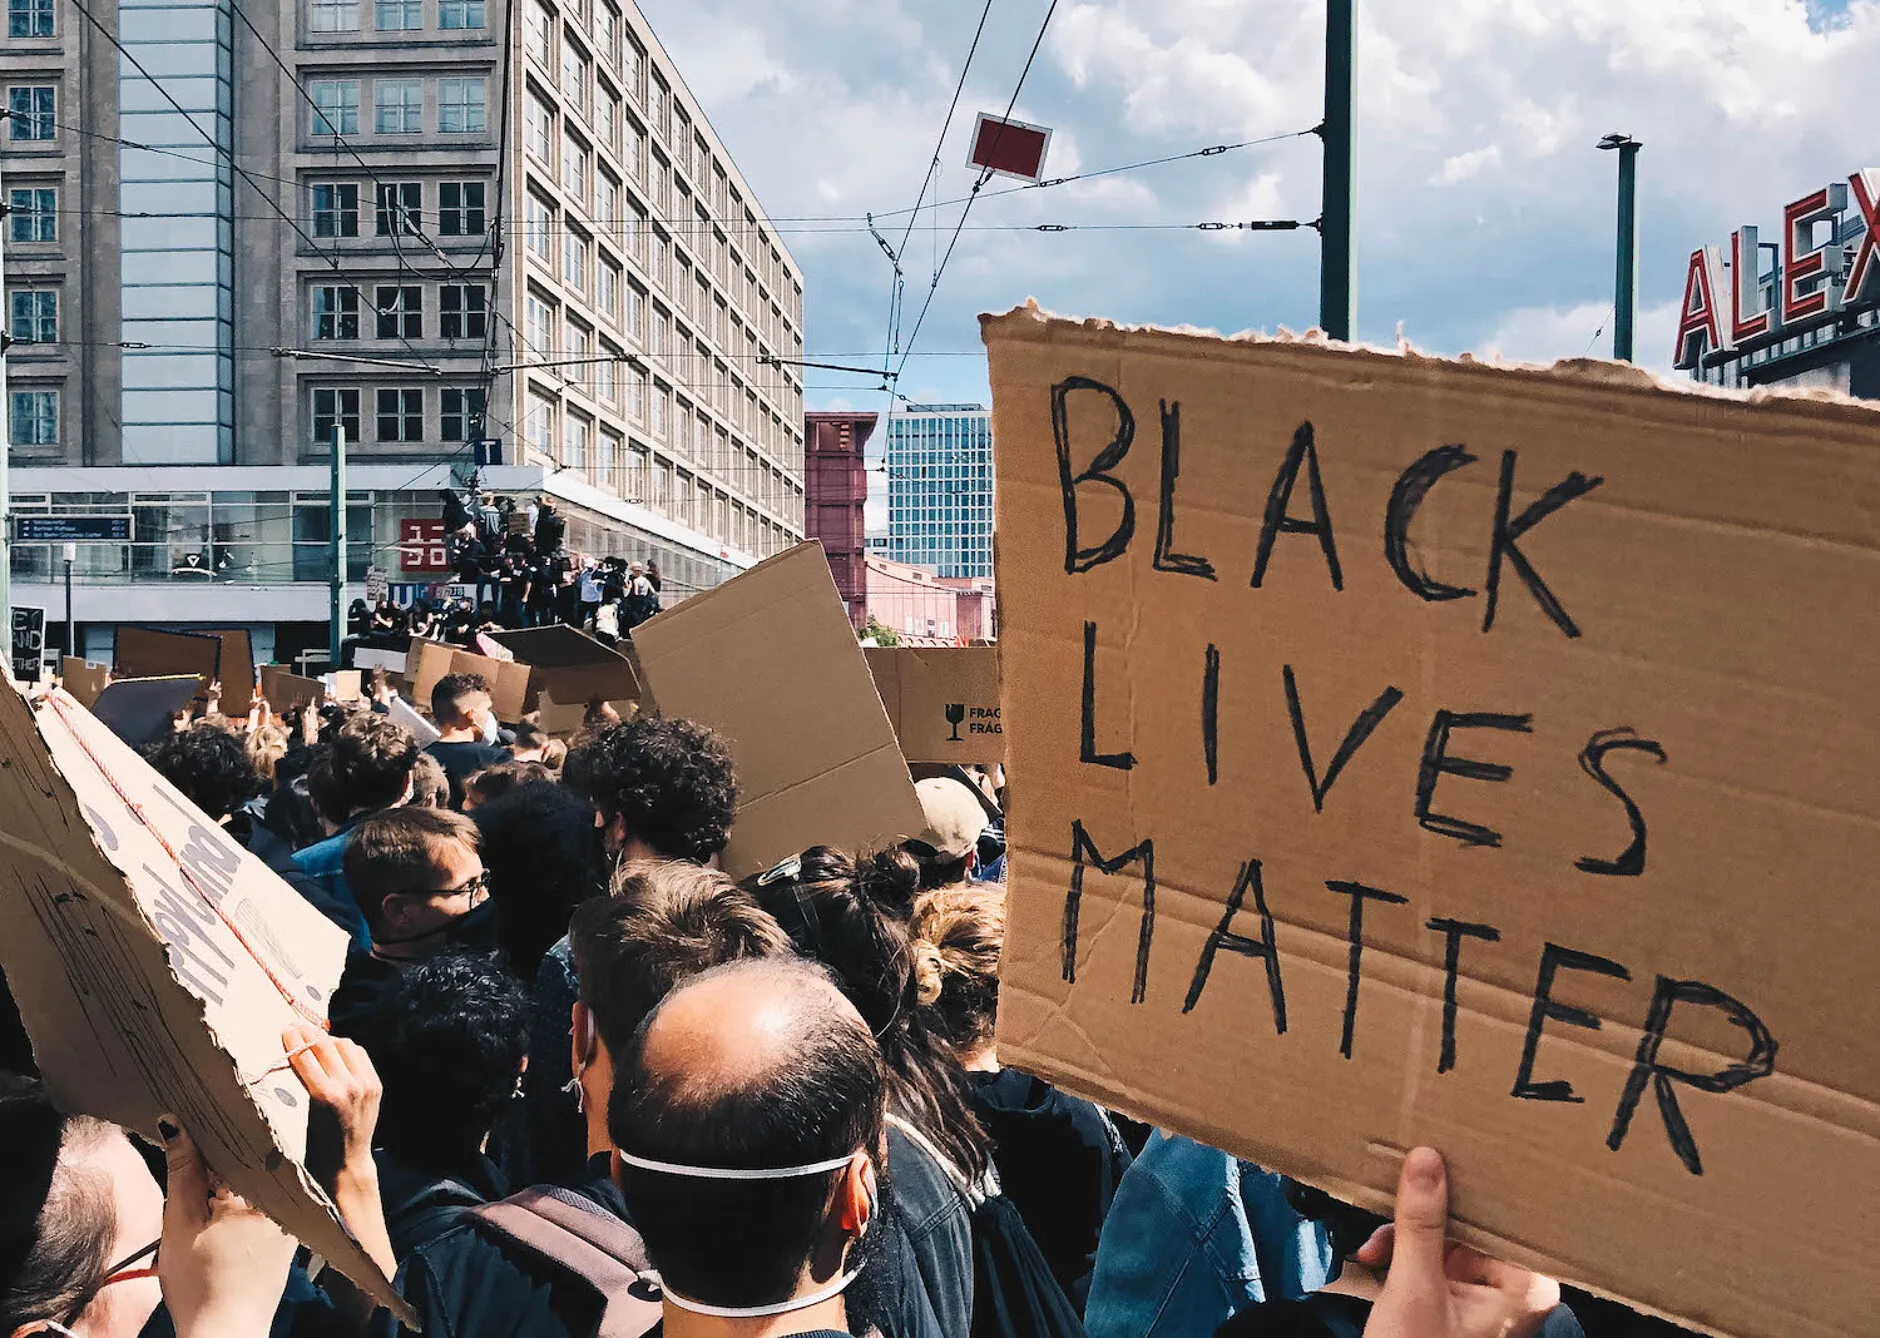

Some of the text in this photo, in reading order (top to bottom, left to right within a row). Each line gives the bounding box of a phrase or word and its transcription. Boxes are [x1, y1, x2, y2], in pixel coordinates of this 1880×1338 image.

[1051, 375, 1605, 638] BLACK
[1080, 620, 1668, 876] LIVES
[1061, 818, 1780, 1177] MATTER
